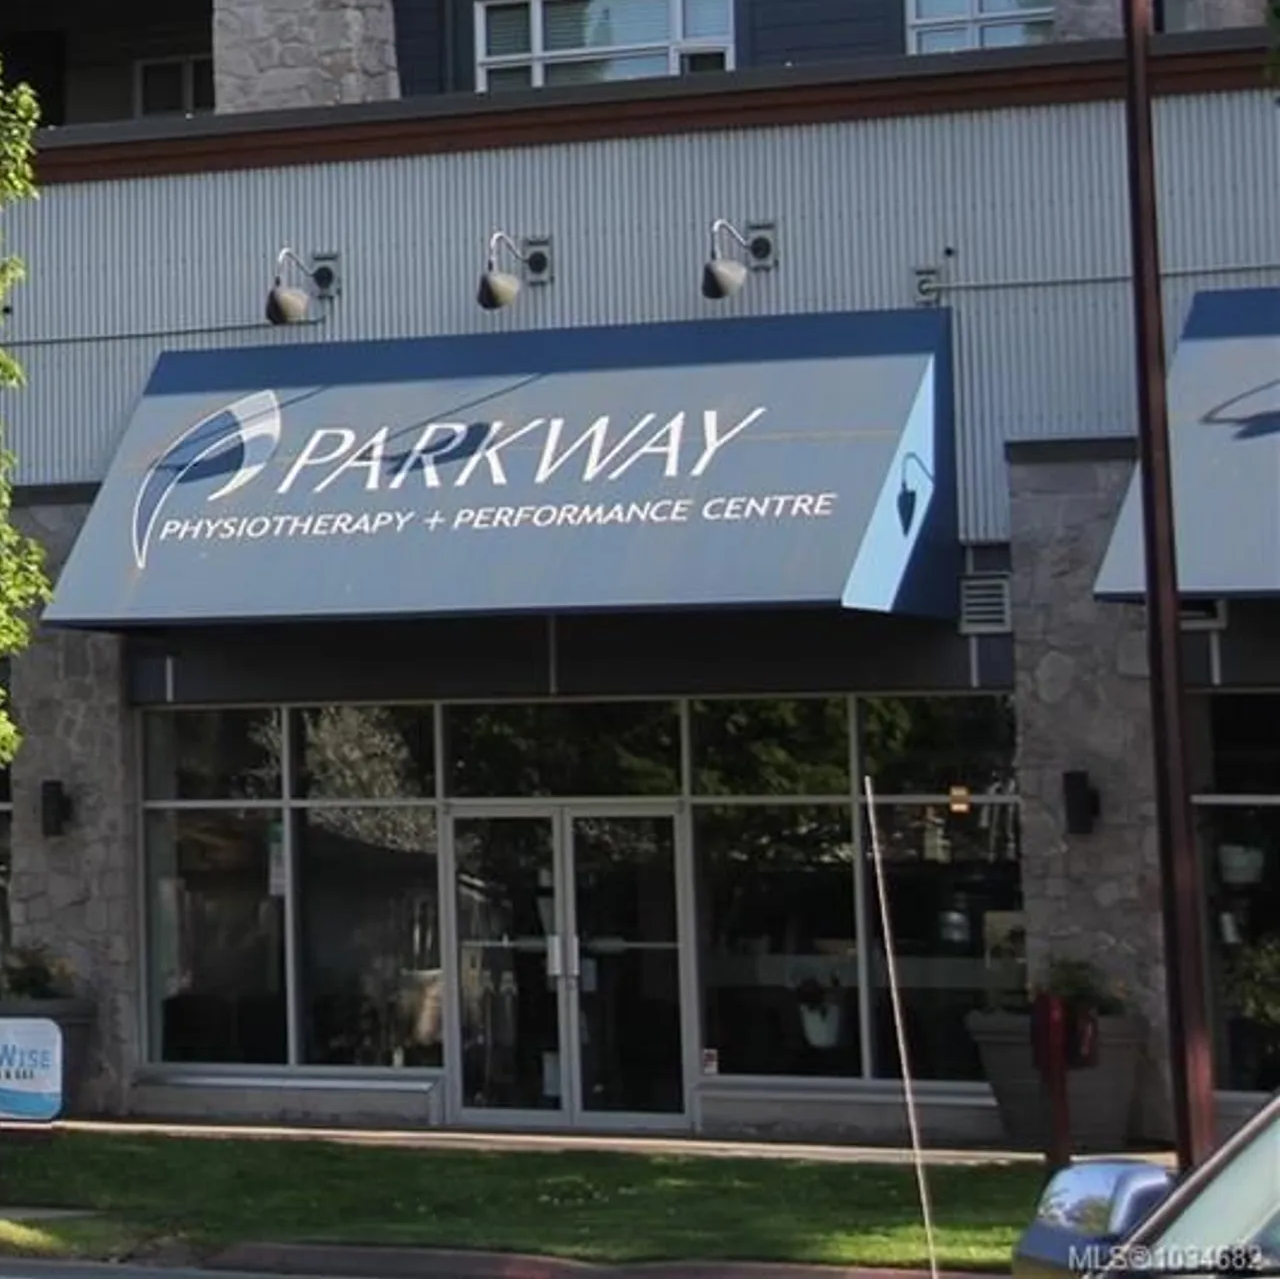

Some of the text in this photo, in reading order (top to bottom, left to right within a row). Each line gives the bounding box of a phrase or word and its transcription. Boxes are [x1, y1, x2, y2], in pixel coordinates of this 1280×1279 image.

[276, 407, 766, 494] PARKWAY
[160, 511, 414, 541] PHYSIOTHERAPY
[453, 498, 694, 531] PERFORMANCE
[702, 492, 839, 521] CENTRE
